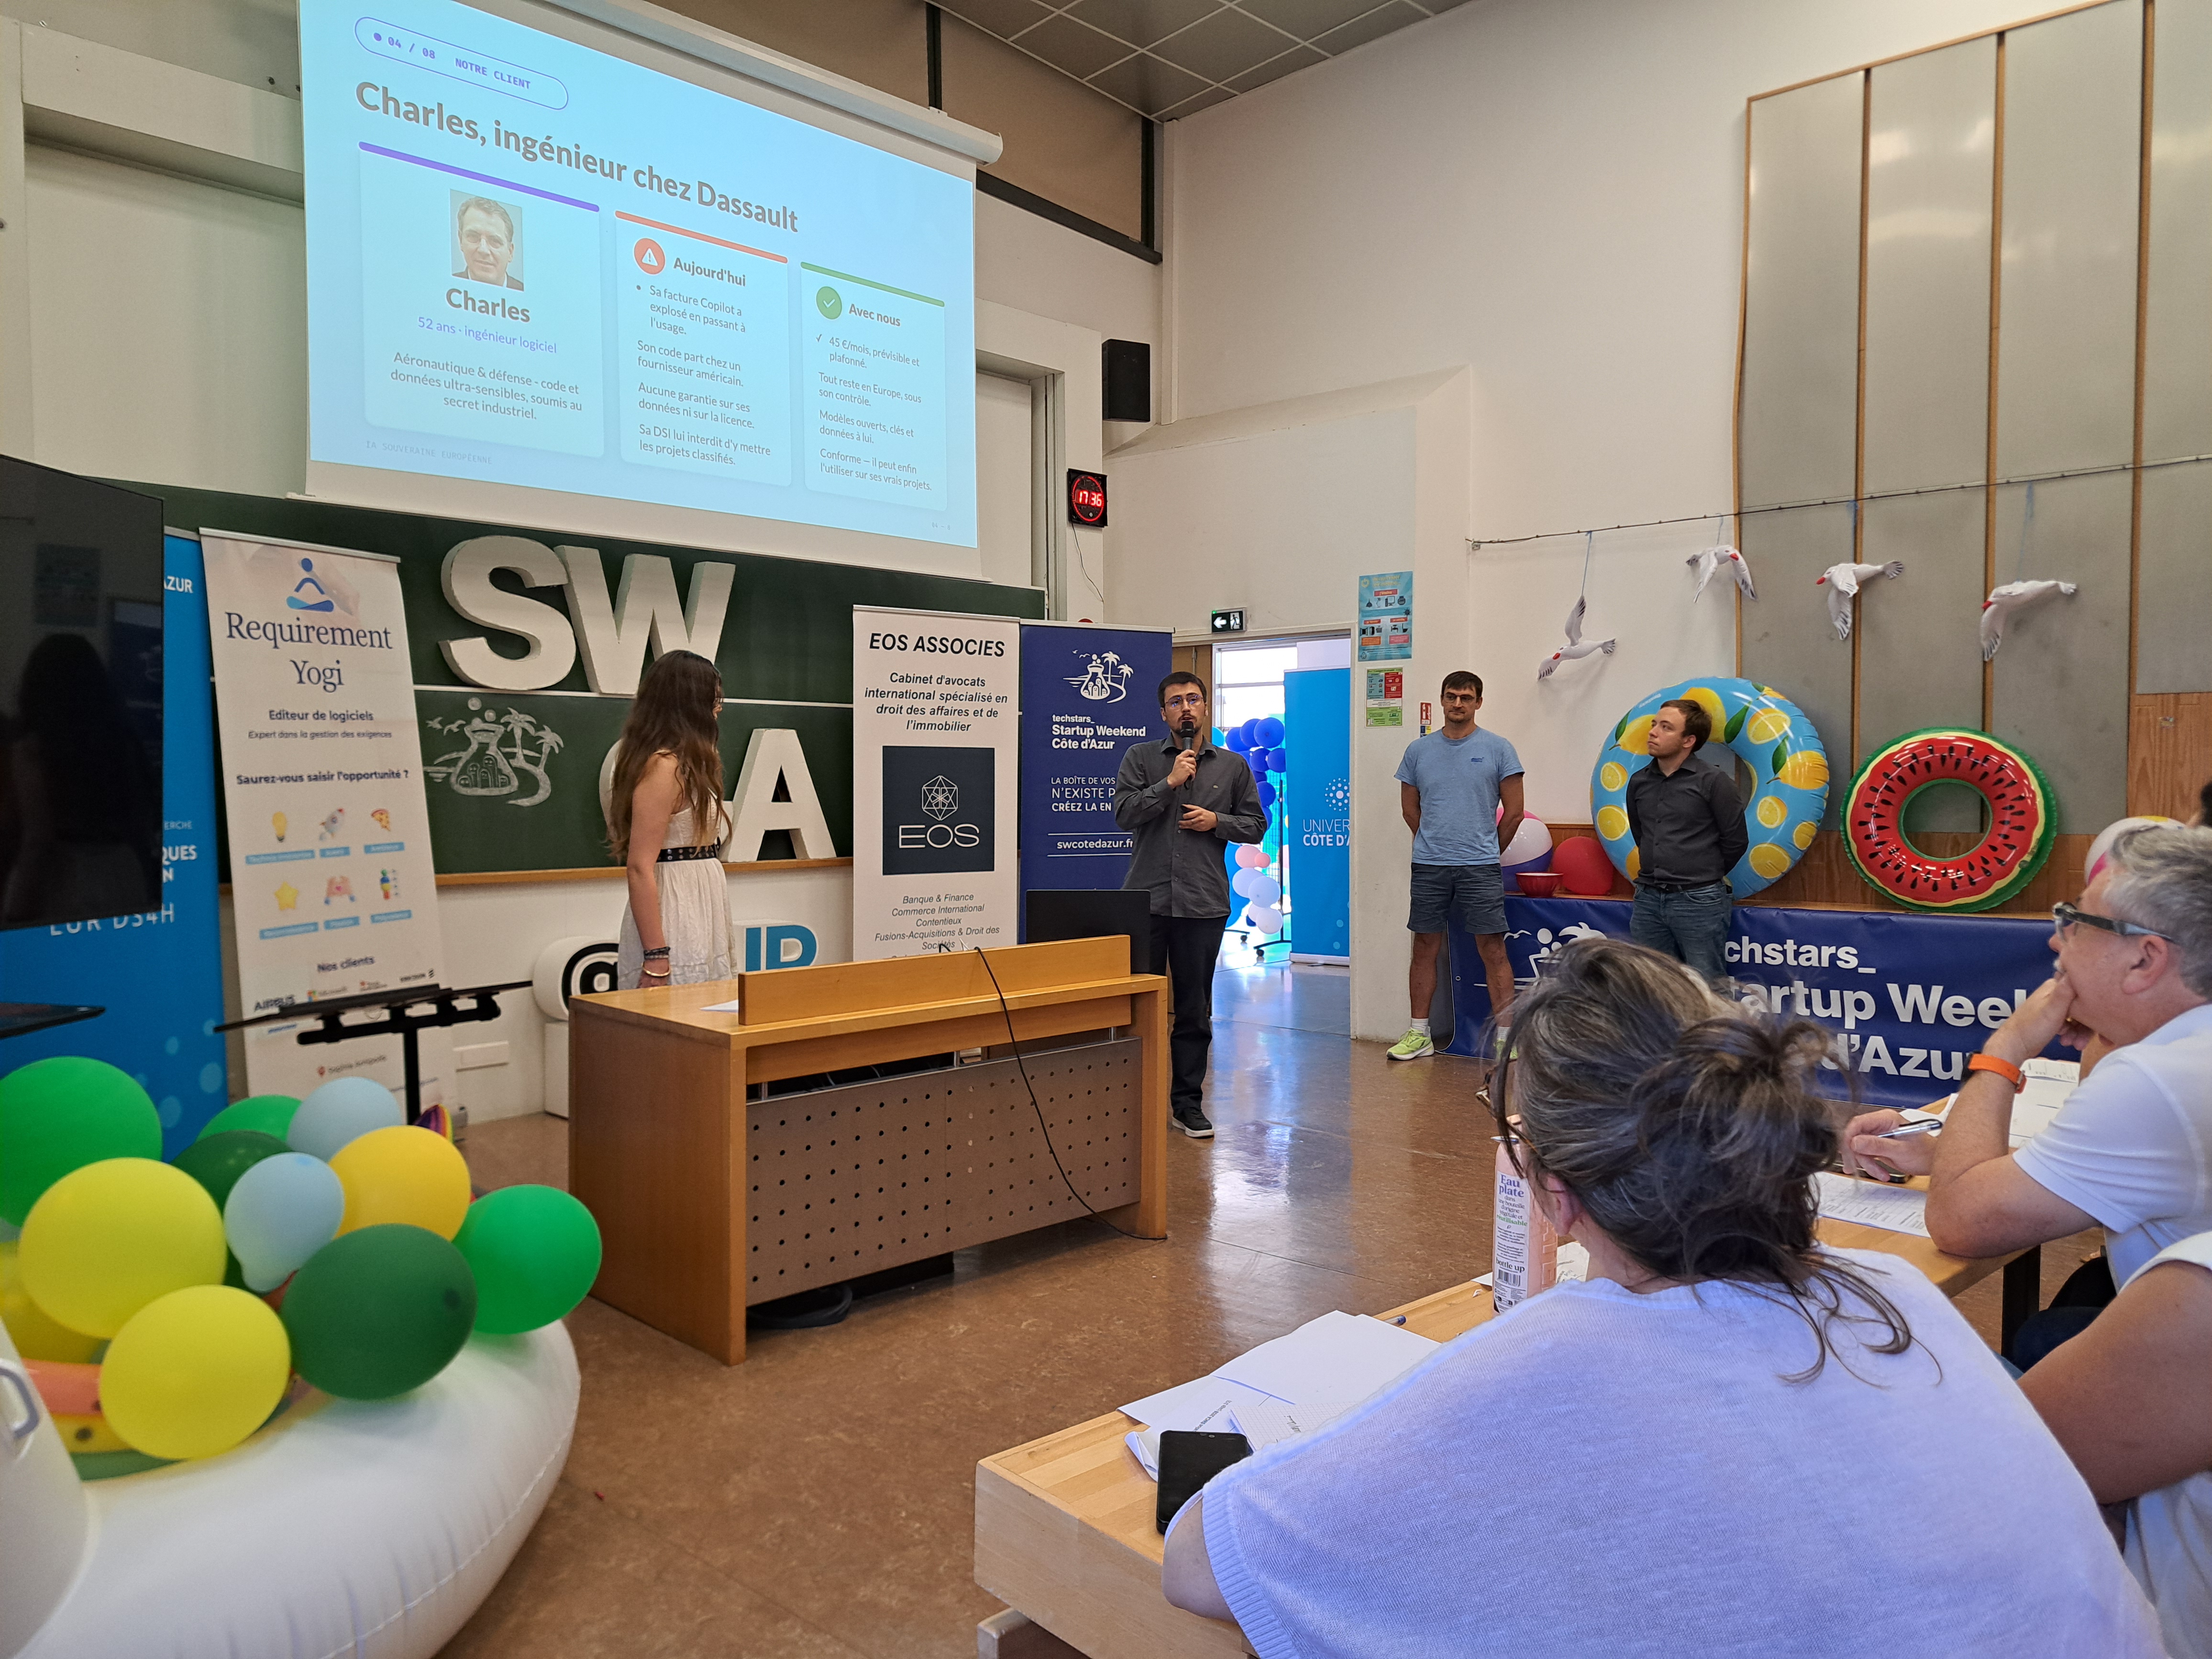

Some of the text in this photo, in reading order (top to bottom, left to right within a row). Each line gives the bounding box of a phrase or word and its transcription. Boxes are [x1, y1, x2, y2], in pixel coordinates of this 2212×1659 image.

[387, 36, 401, 49] 04
[422, 47, 435, 59] 08
[455, 58, 487, 76] NOTRE
[494, 70, 531, 89] CLIENT
[356, 81, 798, 232] Charles, ingénieur chez Dassault
[673, 257, 746, 287] Aujourd'hui
[446, 288, 530, 322] Charles
[650, 285, 742, 316] Sa facture Copilot a
[650, 303, 745, 332] explosé en passant à
[849, 304, 901, 327] Avec nous
[650, 317, 686, 335] l'usage.
[418, 316, 557, 354] 52 ans ingénieur logiciel
[637, 340, 741, 372] Son code part chez un
[829, 336, 920, 367] 45 €/mois, prévisible et
[830, 352, 867, 369] plafonné.
[393, 352, 579, 395] Aéronautique & défense code et
[638, 356, 743, 387] fournisseur américain.
[390, 369, 582, 411] données ultra-sensibles, soumis au
[443, 396, 537, 420] secret industriel.
[639, 424, 771, 455] Sa DSI lui interdit d'y mettre
[366, 440, 377, 449] IA
[382, 442, 436, 457] SOUVERAINE
[640, 439, 736, 465] les projets classifiés.
[820, 462, 932, 491] l'utiliser sur ses vrais projets.
[438, 535, 736, 696] SW
[224, 611, 393, 650] Requirement
[869, 633, 1005, 657] EOS ASSOCIES
[289, 659, 344, 693] Yogi
[890, 672, 985, 687] Cabinet d'avocats
[864, 687, 1007, 703] international spécialisé en
[269, 710, 374, 723] Editeur de logiciels
[876, 704, 998, 718] droit des affaires et de
[906, 720, 972, 731] l'immobilier
[1052, 725, 1146, 738] Startup Weekend
[248, 730, 392, 740] Expert dans la gestion des exigences
[1052, 738, 1115, 749] Côte d'Azur
[236, 768, 409, 785] Saurez-vous saisir l'opportunité ?
[1063, 775, 1085, 785] BOÎTE
[1052, 787, 1104, 798] N'EXISTE
[1052, 800, 1082, 811] CRÉEZ
[1085, 803, 1097, 811] LA
[899, 823, 980, 849] EOS
[1057, 838, 1133, 849] swcotedazur.fr
[1303, 832, 1333, 846] CÔTE
[903, 896, 933, 905] Banque
[944, 894, 974, 902] Finance
[892, 904, 984, 916] Commerce International
[916, 917, 962, 927] Contentieux
[875, 929, 955, 942] Fusions-Acquisitions
[966, 927, 984, 936] Droit
[1501, 1173, 1520, 1188] Eau
[1499, 1184, 1524, 1197] plate
[1496, 1256, 1525, 1273] bottle up
